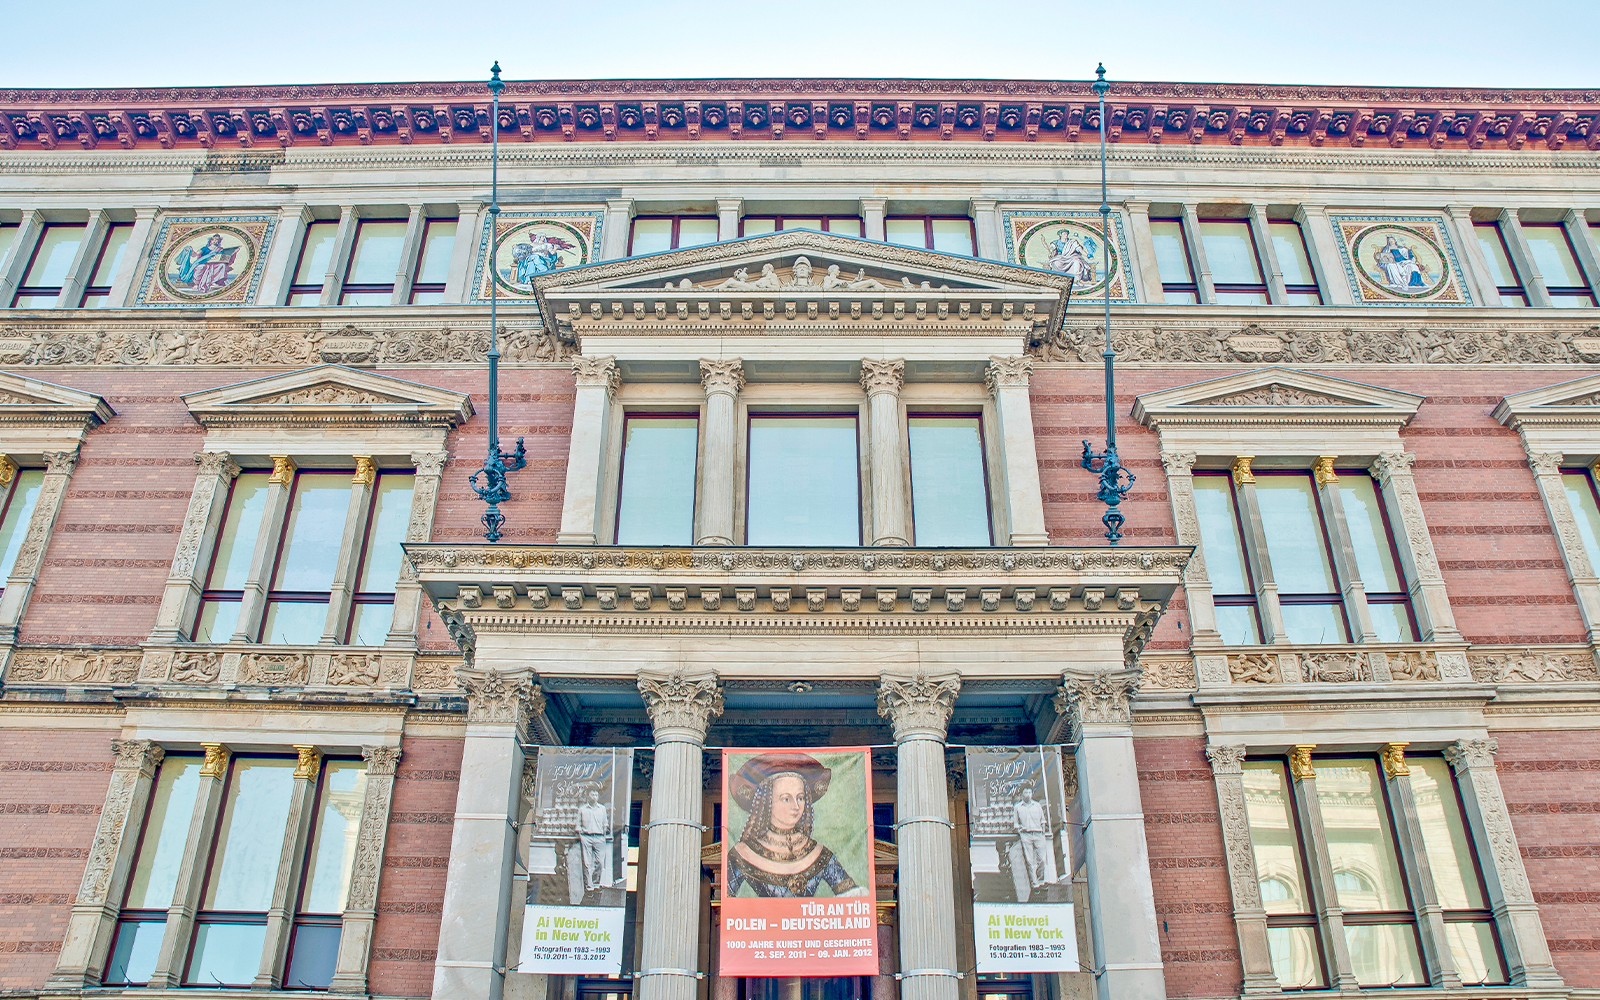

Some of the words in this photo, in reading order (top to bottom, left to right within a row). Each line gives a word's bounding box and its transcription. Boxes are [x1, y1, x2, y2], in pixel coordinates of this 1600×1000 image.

[801, 901, 825, 916] TÜR
[827, 904, 844, 915] AN
[846, 900, 870, 915] TÜR
[536, 916, 549, 928] Ai
[554, 916, 599, 929] Weiwei
[726, 918, 767, 931] POLEN
[781, 916, 871, 930] DEUTSCHLAND
[988, 914, 1000, 926] Ai
[1004, 914, 1049, 926] Weiwei
[535, 929, 548, 940] in
[552, 929, 580, 941] New
[583, 930, 611, 942] York
[988, 927, 1000, 939] in
[1004, 927, 1032, 939] New
[1035, 927, 1064, 939] York
[533, 945, 572, 953] Fotografien
[726, 941, 746, 949] 1000
[748, 940, 774, 949] JAHRE
[776, 940, 802, 948] KUNST
[804, 939, 821, 948] UND
[823, 938, 872, 948] GESCHICHTE
[989, 944, 1027, 952] Fotografien
[754, 950, 767, 959] 23.
[769, 950, 786, 959] SEP.
[788, 950, 807, 958] 2011
[817, 950, 831, 958] 09.
[833, 949, 851, 958] JAN.
[853, 948, 872, 957] 2012
